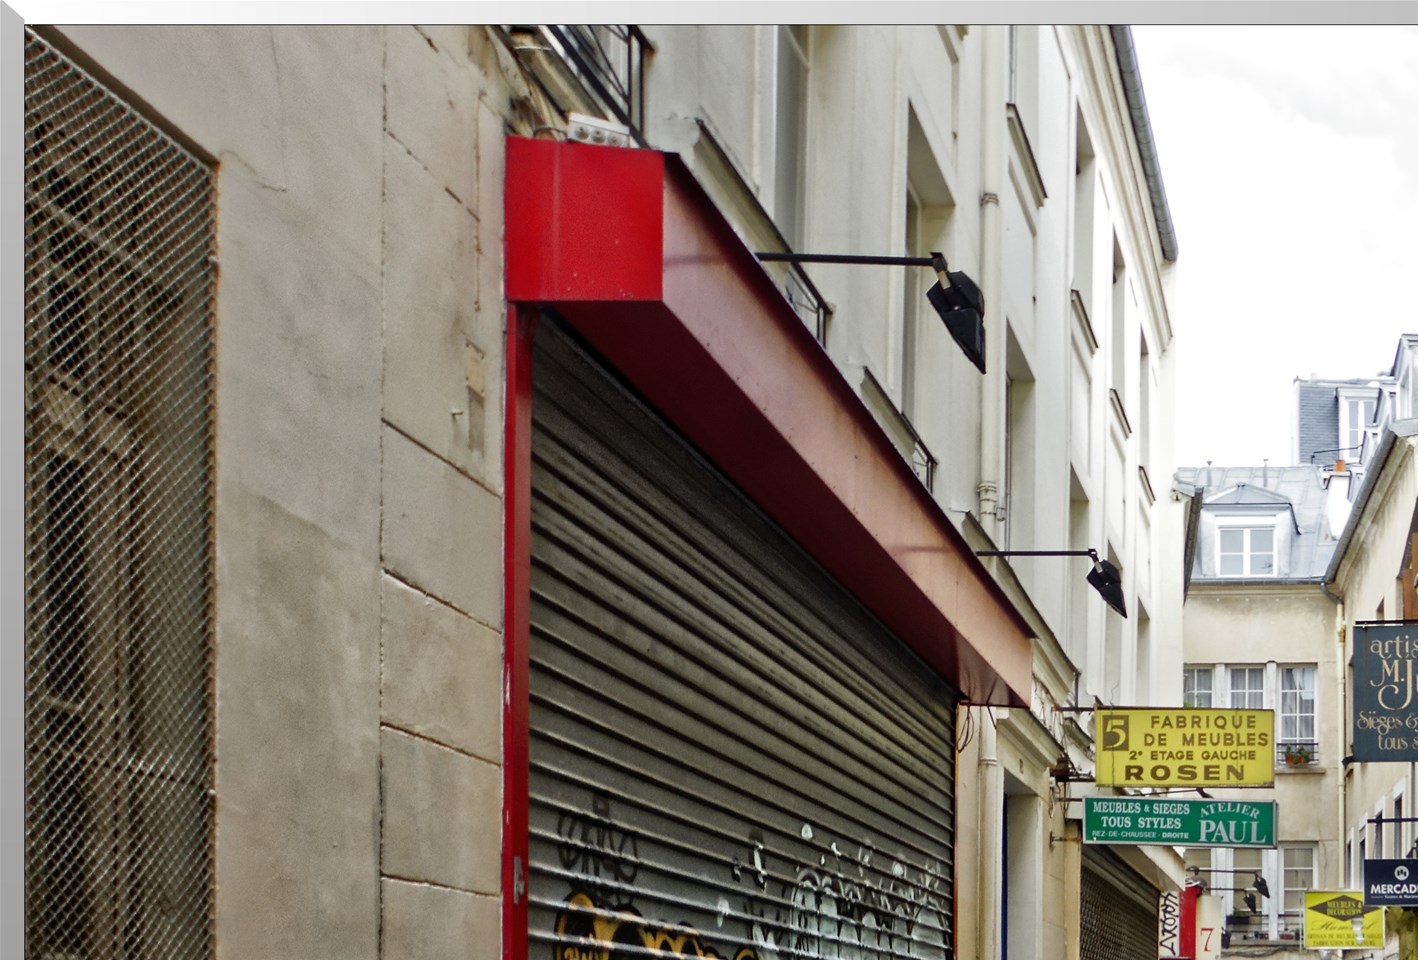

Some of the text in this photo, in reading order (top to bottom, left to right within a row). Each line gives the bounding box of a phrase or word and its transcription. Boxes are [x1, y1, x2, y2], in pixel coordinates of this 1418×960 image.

[1151, 715, 1256, 729] FABRIQUE
[1405, 712, 1418, 729] &
[1105, 718, 1126, 749] 5
[1144, 732, 1269, 746] DE MEUBLES
[1378, 734, 1408, 750] tous
[1151, 751, 1194, 760] ETAGE
[1201, 750, 1256, 760] GAUCHE
[1125, 765, 1245, 781] ROSEN
[1093, 801, 1190, 814] MEUBLES & SIEGES
[1200, 802, 1260, 819] ATELIER
[1101, 816, 1182, 829] TOUS STYLES
[1198, 820, 1266, 843] PAUL
[1201, 928, 1213, 952] 7
